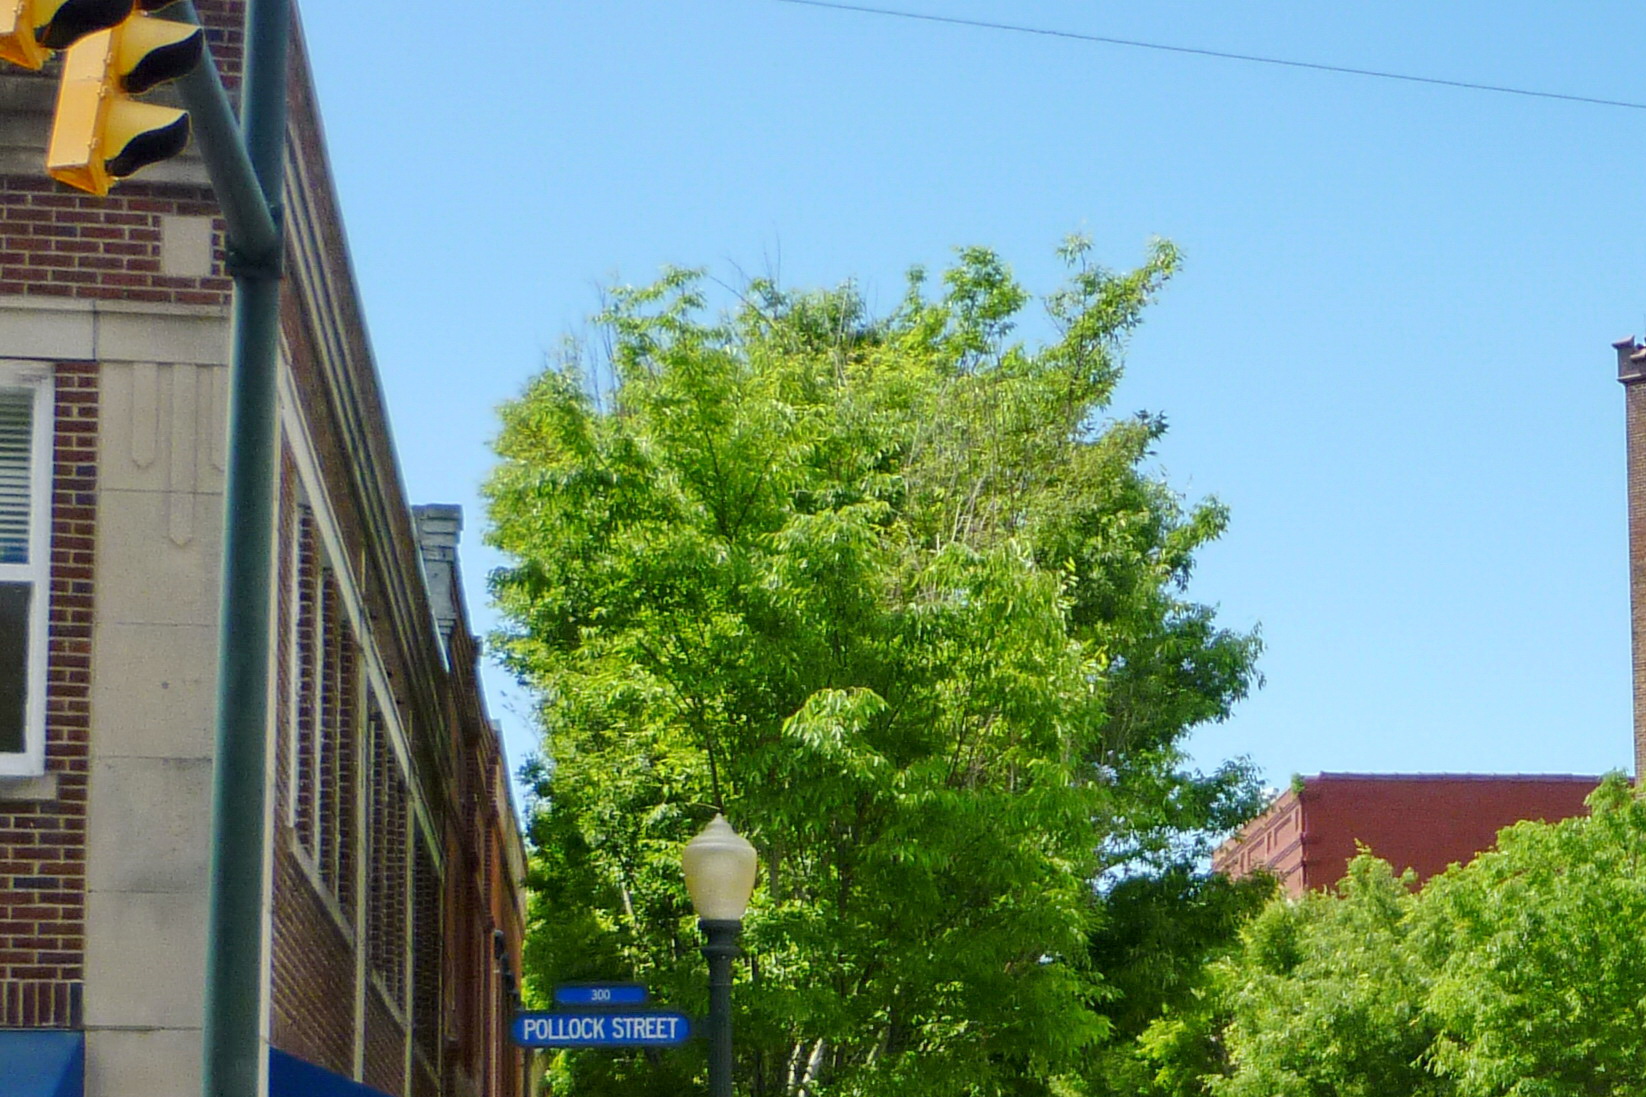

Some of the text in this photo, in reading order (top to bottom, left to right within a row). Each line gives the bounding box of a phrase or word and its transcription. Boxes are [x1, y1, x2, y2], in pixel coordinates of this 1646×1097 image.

[592, 988, 611, 1001] 300
[524, 1017, 679, 1040] POLLOCK STREET
